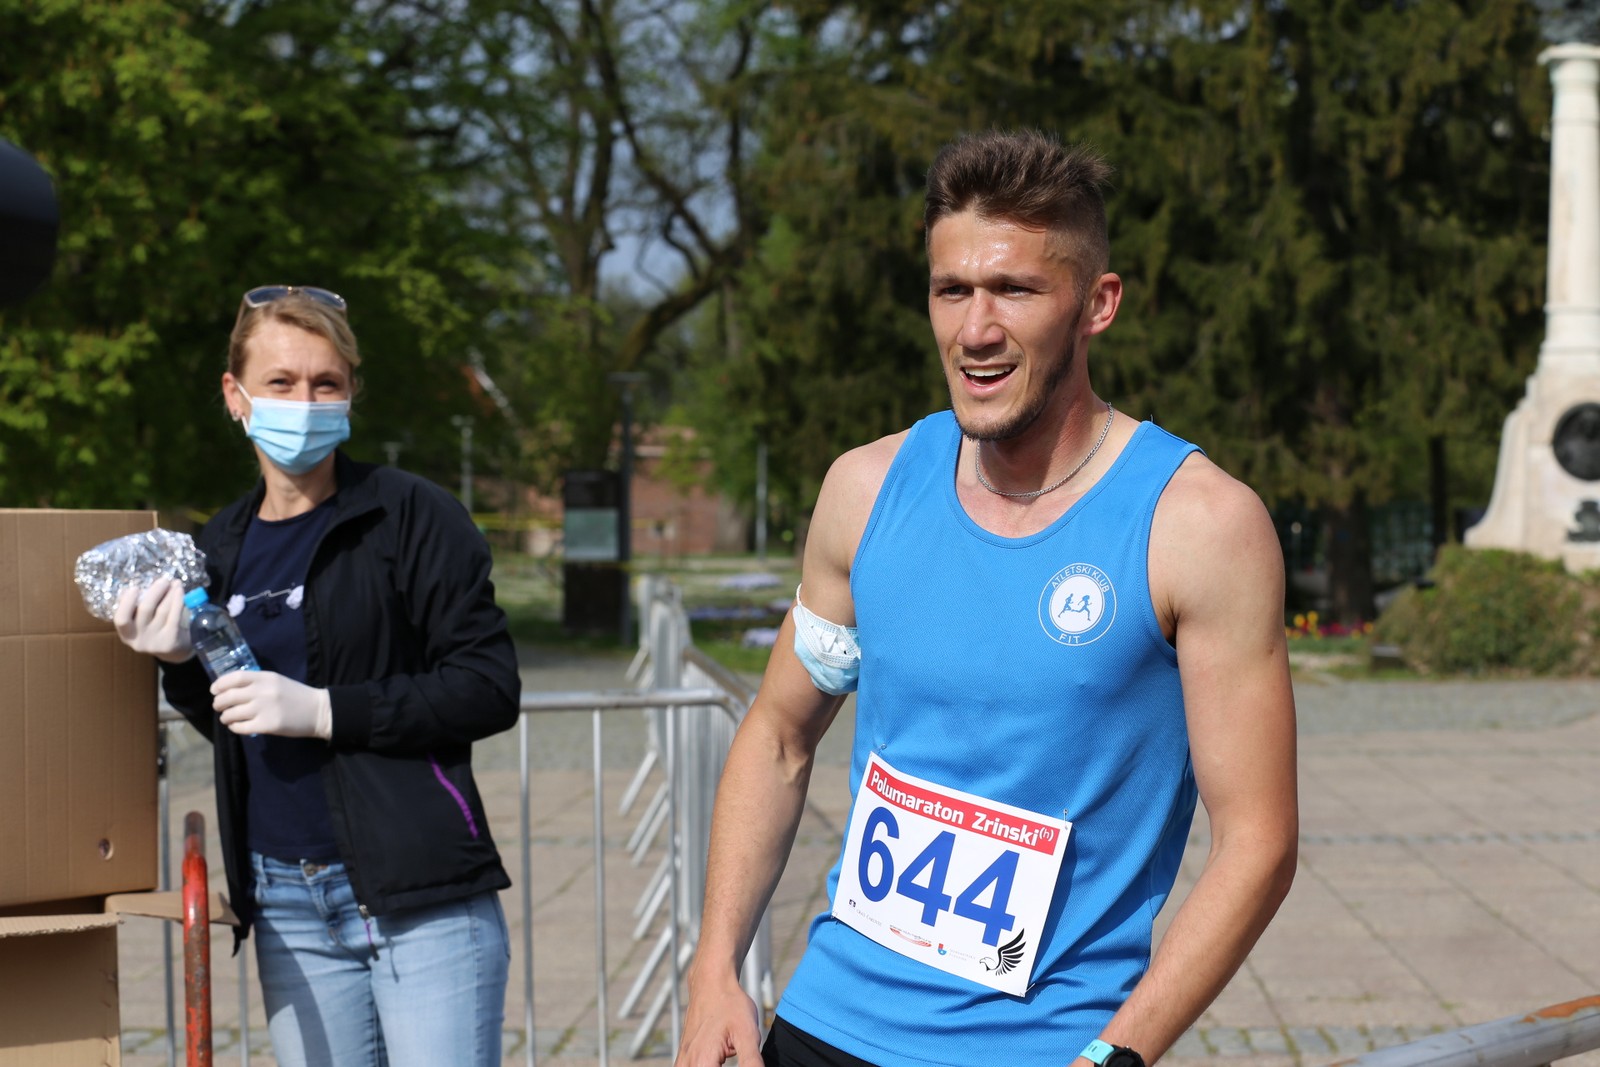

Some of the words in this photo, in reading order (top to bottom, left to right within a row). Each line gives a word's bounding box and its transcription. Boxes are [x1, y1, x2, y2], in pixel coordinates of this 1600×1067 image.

[1051, 565, 1092, 589] ATLETSKI
[1091, 570, 1110, 593] KLUB
[1059, 633, 1080, 644] FIT
[870, 770, 965, 825] Polumaraton
[857, 806, 1020, 947] 644
